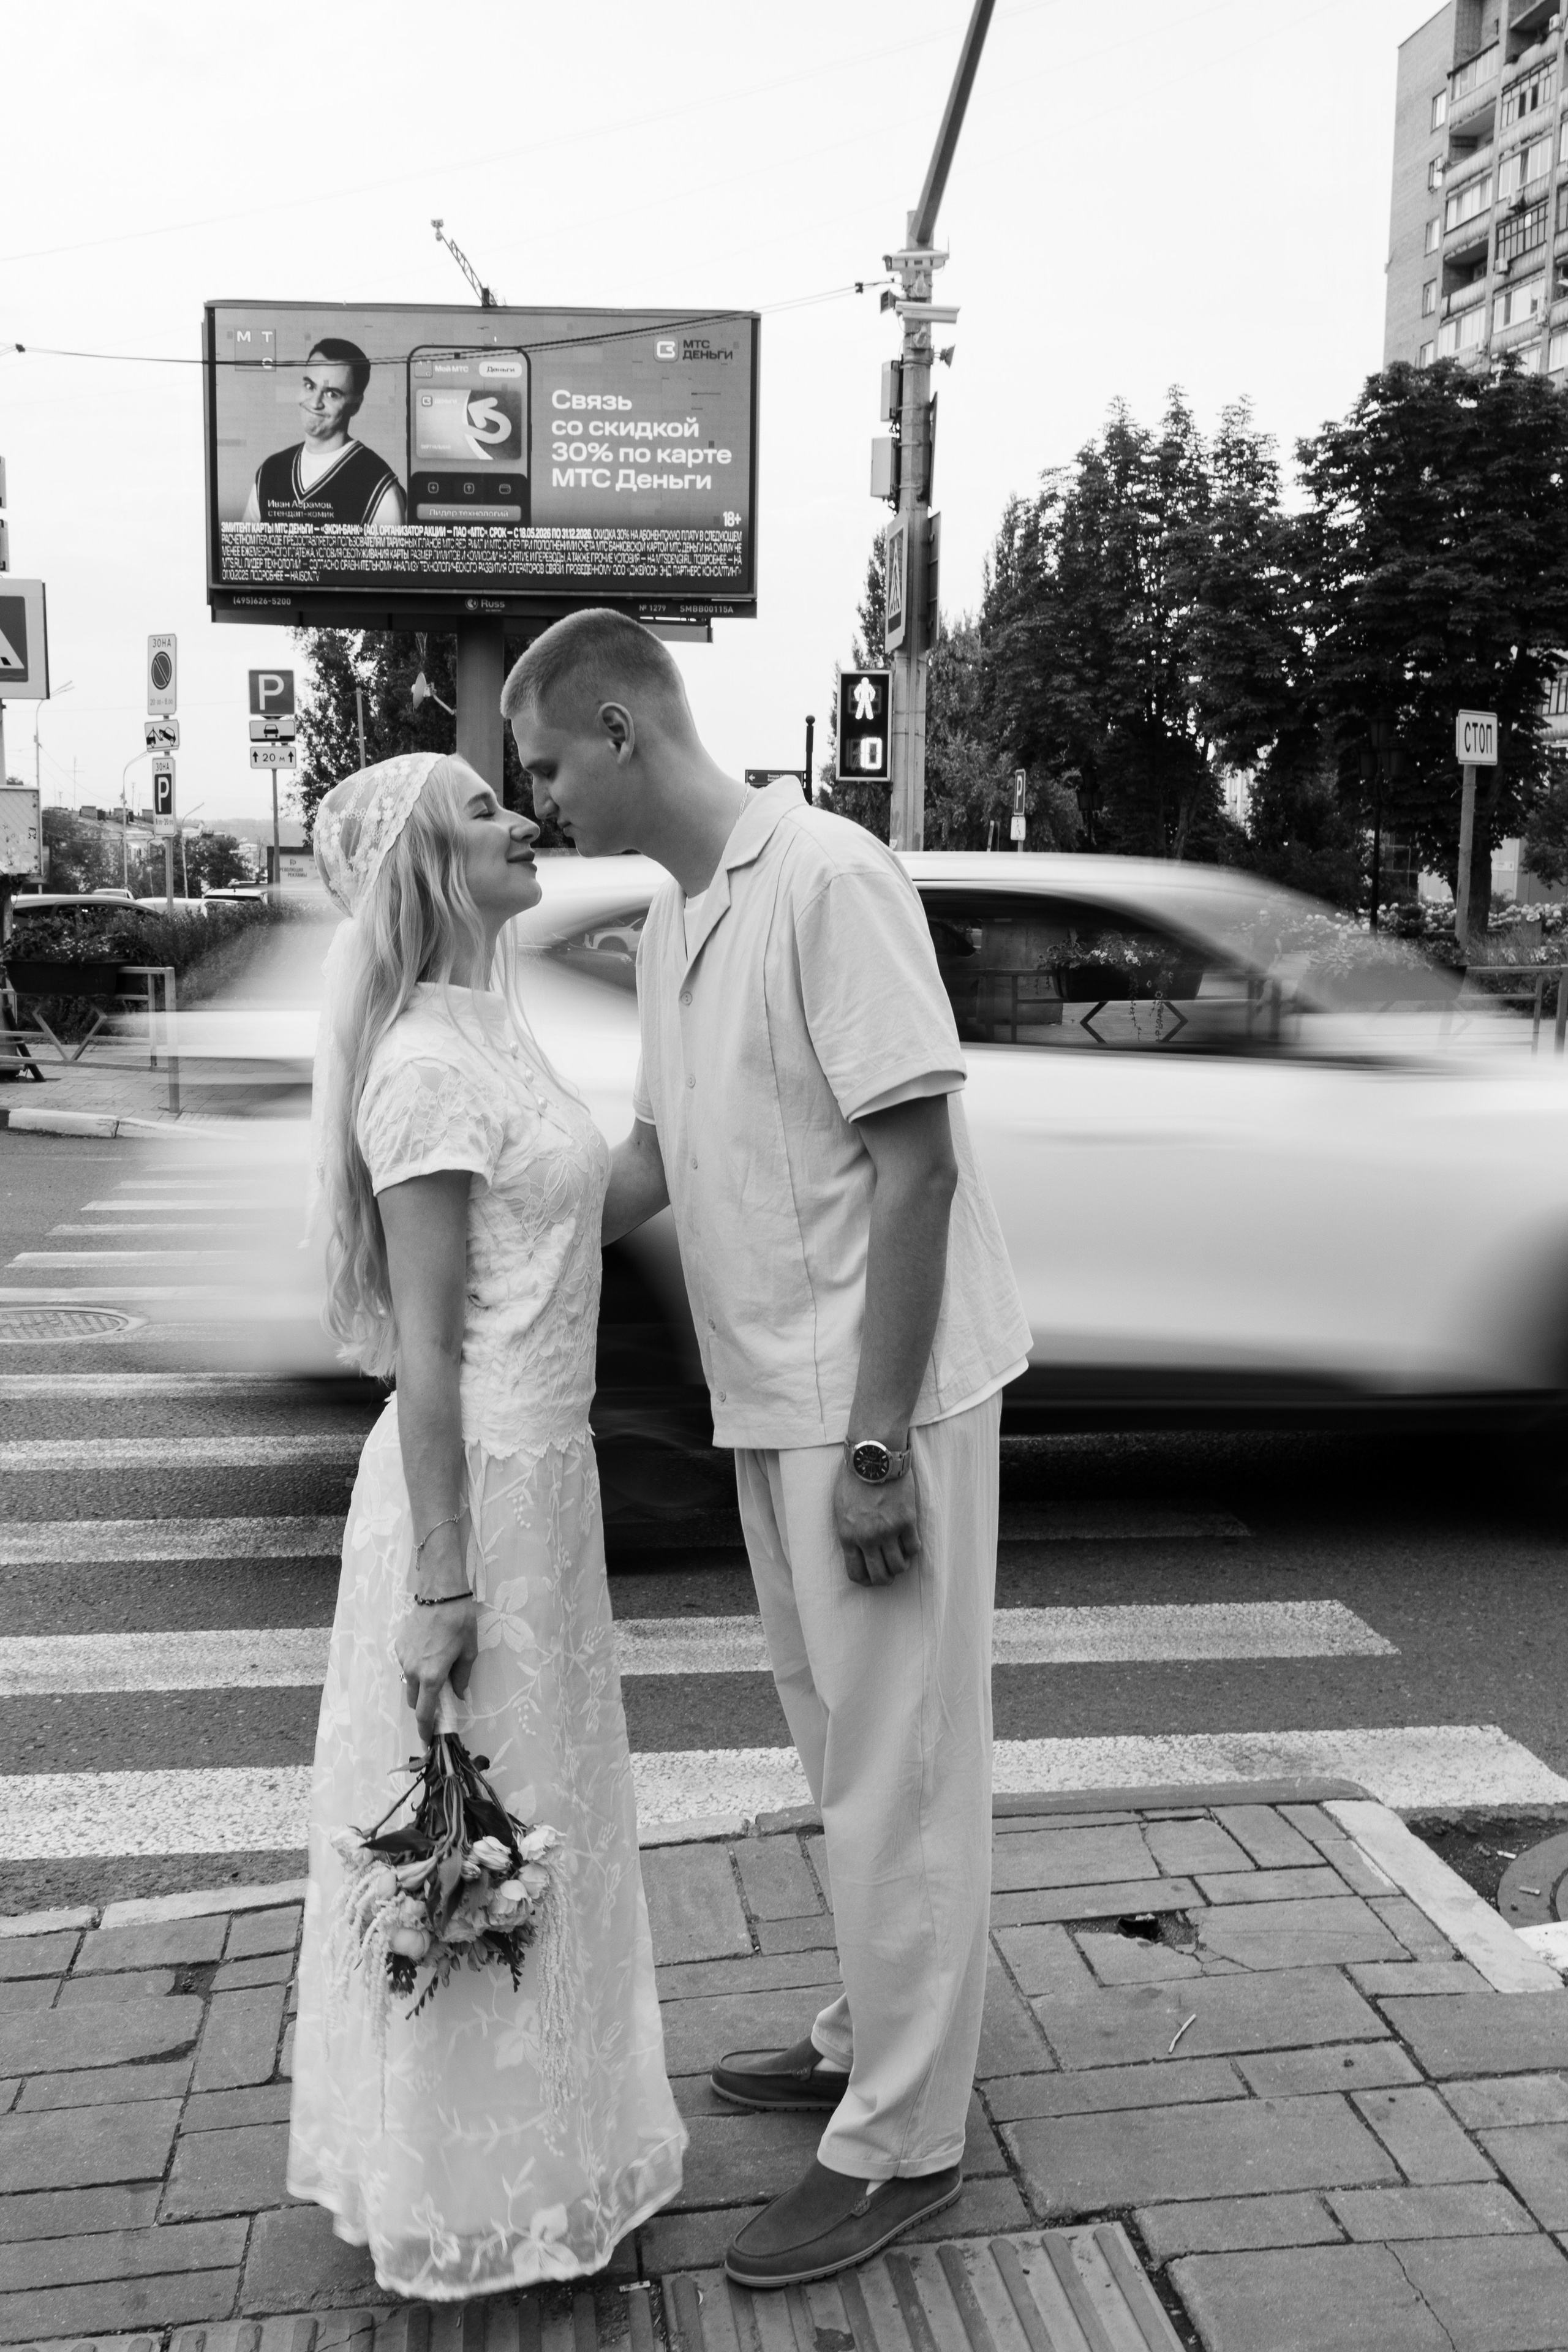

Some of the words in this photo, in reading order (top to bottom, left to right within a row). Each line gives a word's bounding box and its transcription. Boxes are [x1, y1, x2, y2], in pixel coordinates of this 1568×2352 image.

[683, 339, 710, 349] МТС
[682, 350, 733, 360] ДЕНЬГИ
[551, 390, 633, 410] Связь
[551, 420, 583, 435] со
[589, 417, 699, 440] скидкой
[551, 442, 613, 462] 30%
[619, 448, 651, 462] по
[657, 448, 732, 468] карте
[552, 468, 611, 488] МТС
[615, 469, 711, 492] Деньги
[268, 499, 290, 508] Иван
[292, 500, 334, 510] Абрамов,
[429, 508, 457, 518] Лидер
[723, 511, 741, 527] 18+
[221, 522, 251, 533] ЭМИТЕНТ
[251, 522, 273, 533] КАРТЫ
[274, 522, 288, 533] МТС
[288, 523, 314, 533] ДЕНЬГИ
[380, 524, 424, 535] ОРГАНИЗАТОР
[424, 525, 446, 536] АКЦИИ
[453, 526, 467, 537] ПАО
[489, 526, 507, 537] СРОК
[551, 527, 561, 538] ПО
[593, 528, 616, 539] СКИДКА
[233, 596, 292, 605] (495)626-5200
[481, 598, 505, 608] Russ
[153, 638, 172, 648] ЗОНА
[258, 674, 284, 710] P
[1464, 722, 1492, 754] СТОП
[262, 753, 276, 762] 20
[156, 763, 170, 771] ЗОНА
[158, 776, 170, 812] P
[1016, 775, 1022, 809] P
